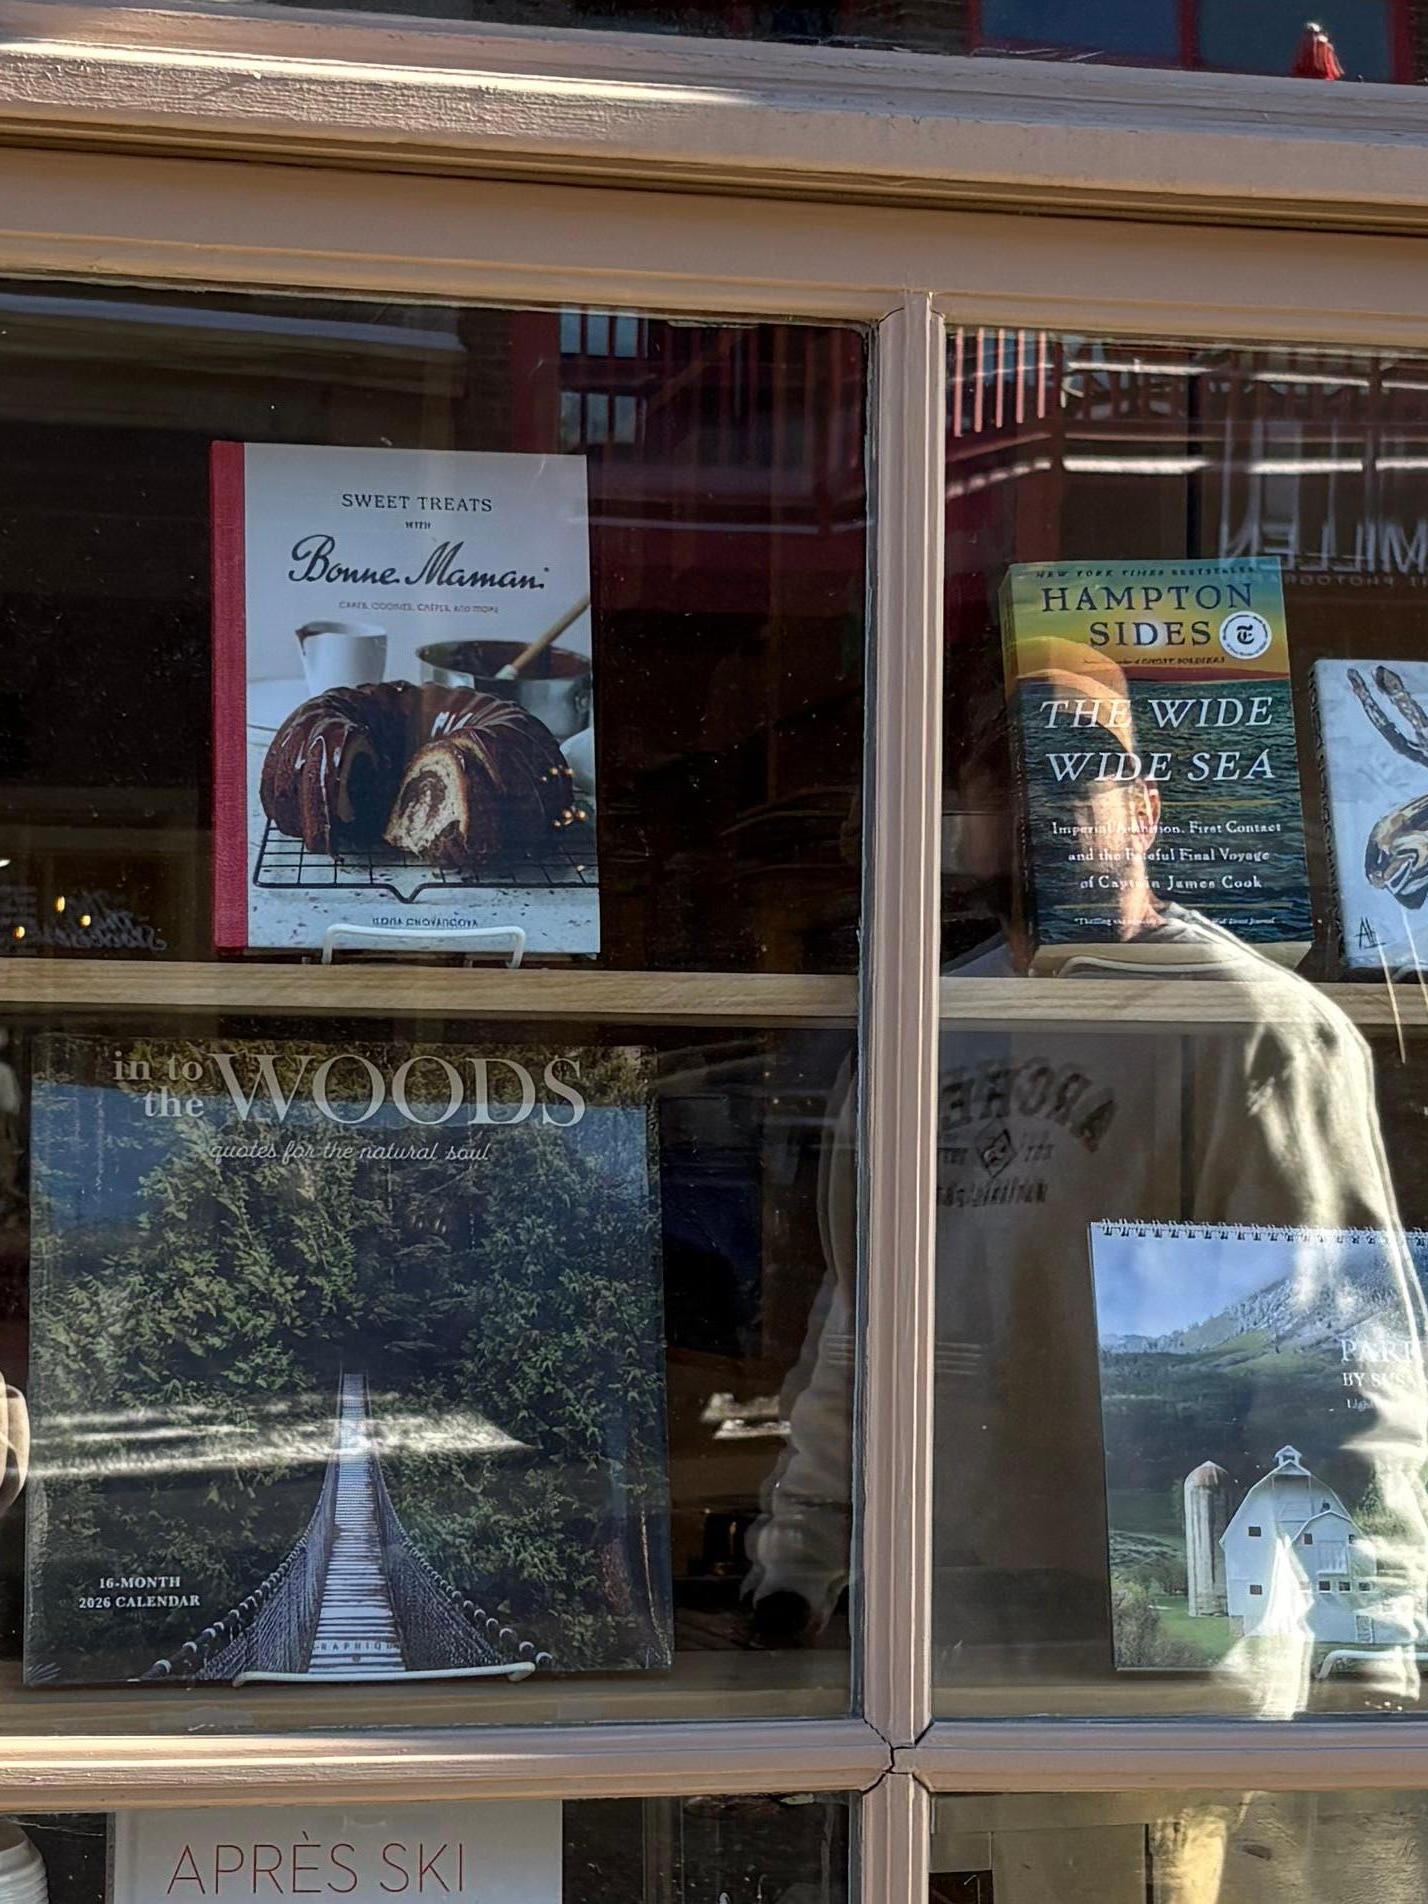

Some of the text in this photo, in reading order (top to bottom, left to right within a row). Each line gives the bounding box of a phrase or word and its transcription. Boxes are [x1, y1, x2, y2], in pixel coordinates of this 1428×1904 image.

[342, 493, 492, 512] SWEET TREATS
[405, 521, 431, 529] WITH
[288, 534, 400, 585] Bonne
[1036, 570, 1068, 578] NEW
[1076, 569, 1114, 577] YORK
[1122, 569, 1164, 577] TIMES
[1042, 583, 1253, 612] HAMPTON
[1089, 621, 1212, 647] SIDES
[1040, 696, 1273, 729] THE WIDE
[1045, 748, 1276, 782] WIDE SEA
[1189, 821, 1223, 835] First
[1225, 820, 1281, 834] Contact
[1068, 848, 1093, 861] and
[1099, 848, 1123, 861] the
[1179, 848, 1215, 861] Final
[1219, 848, 1270, 864] Voyage
[1080, 876, 1093, 889] of
[1167, 876, 1216, 890] James
[1221, 876, 1262, 890] Cook
[111, 1051, 587, 1126] in to WOODS
[143, 1086, 205, 1119] the
[209, 1140, 489, 1165] quotes for the natural soul
[1342, 1372, 1365, 1387] BY
[99, 1576, 181, 1589] 16-MONTH
[78, 1594, 200, 1609] 2026 CALENDAR
[166, 1830, 464, 1895] APRÈS SKI
